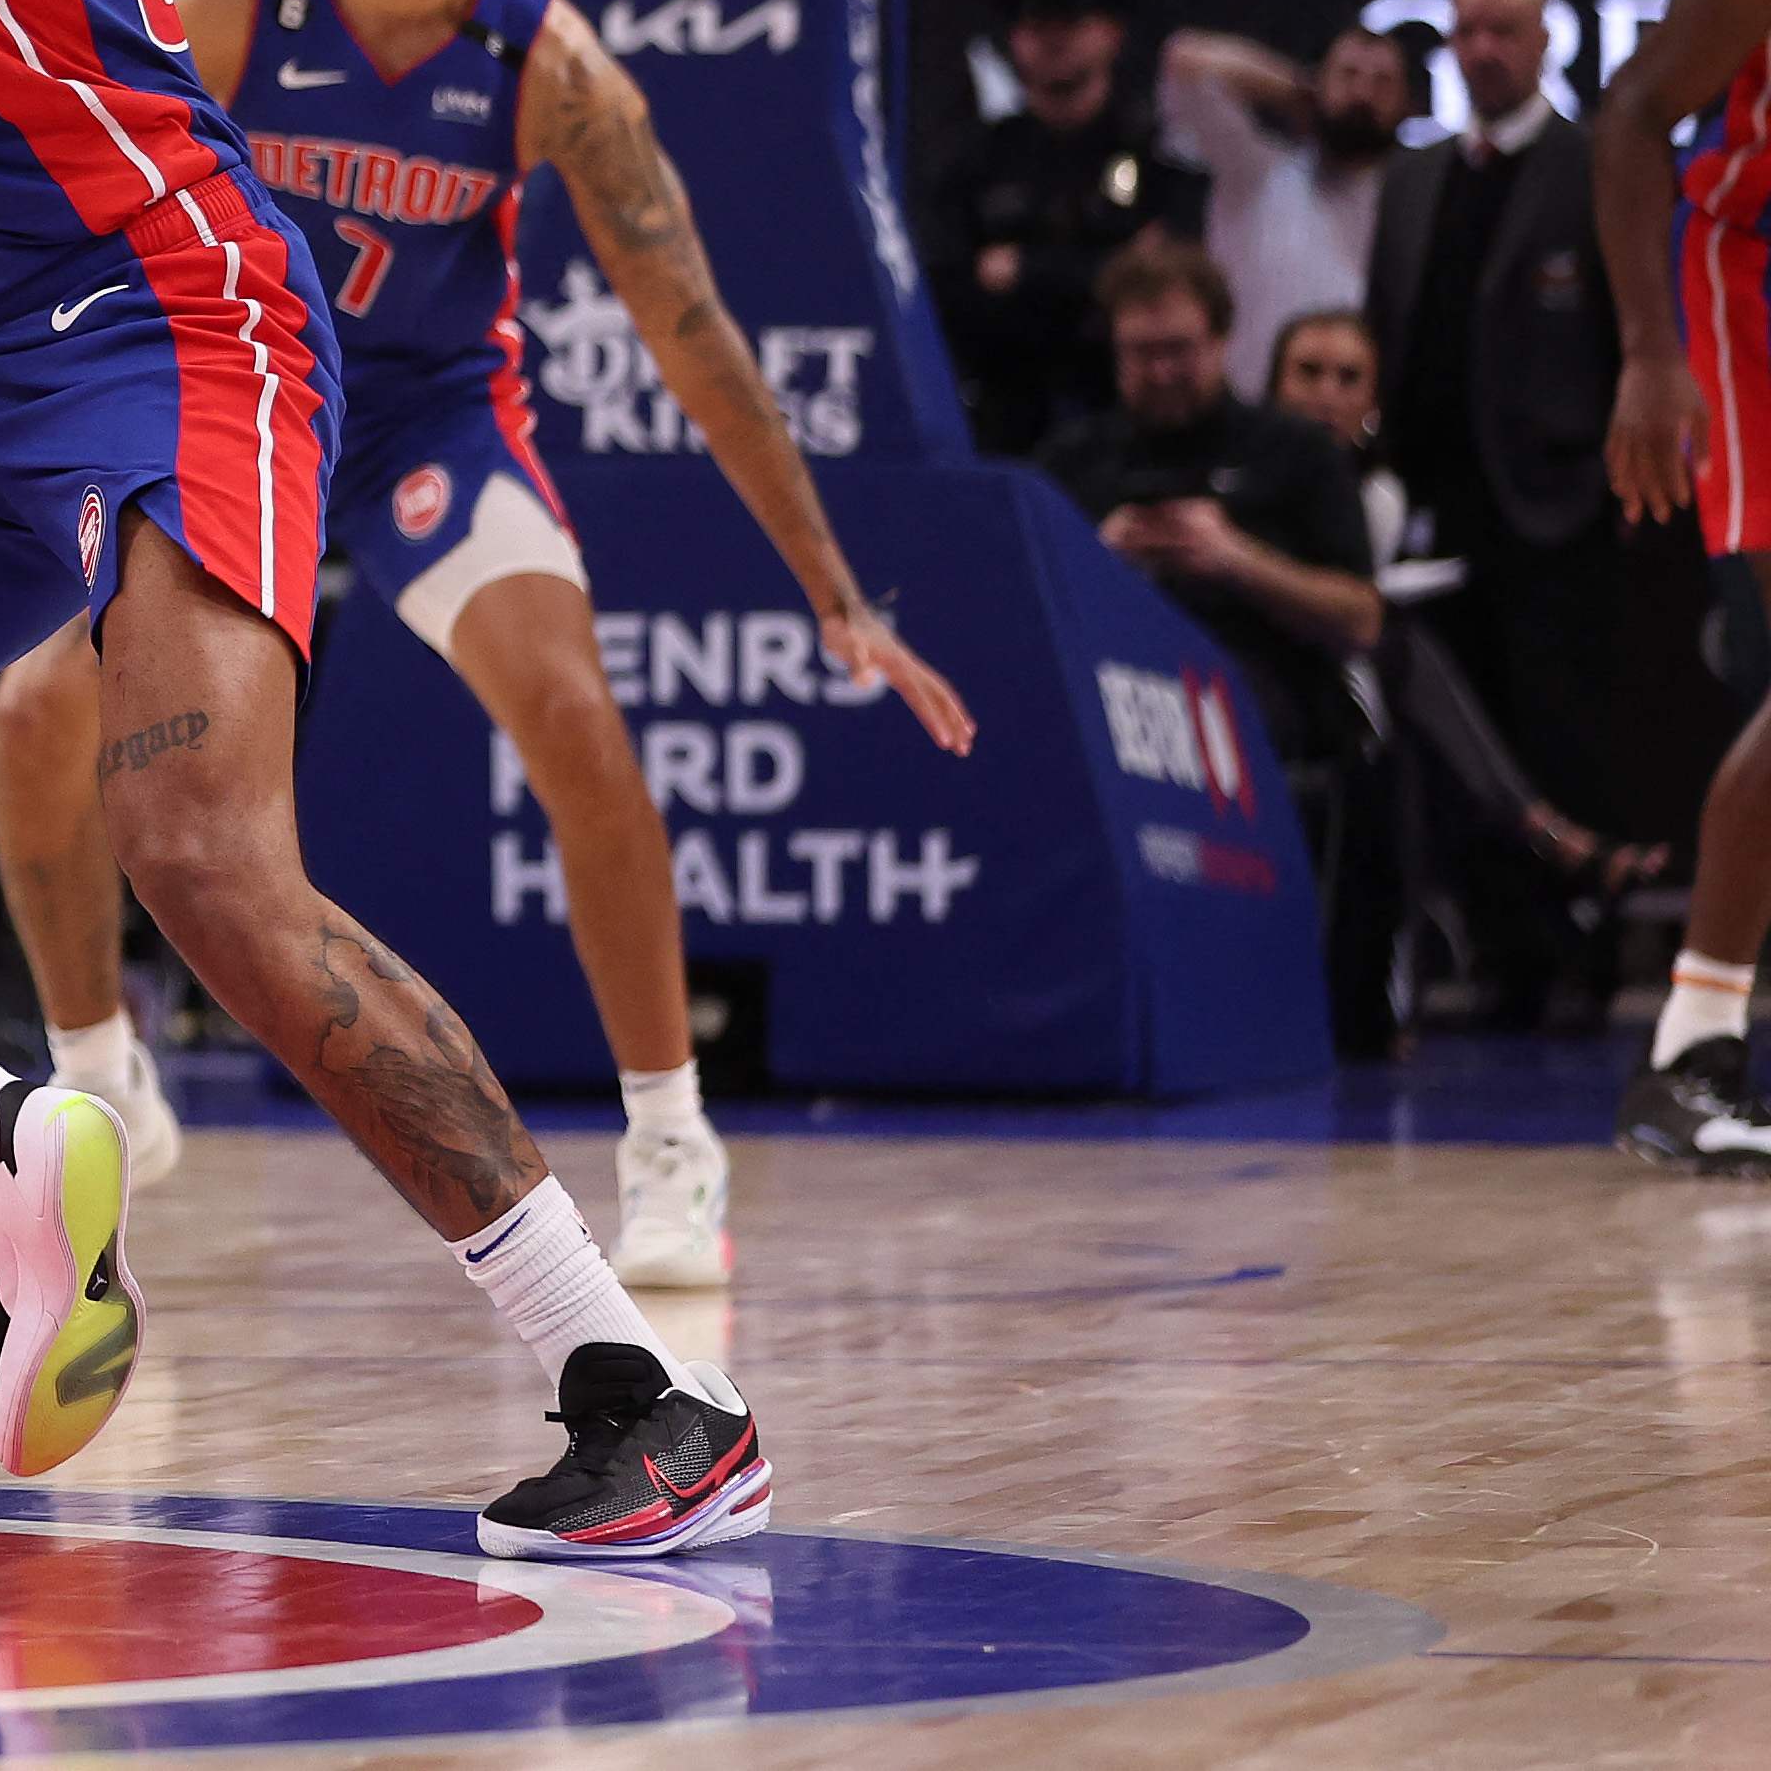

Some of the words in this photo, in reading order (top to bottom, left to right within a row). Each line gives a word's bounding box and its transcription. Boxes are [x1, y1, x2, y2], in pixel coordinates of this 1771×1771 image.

[249, 132, 499, 225] DETROIT
[333, 217, 395, 318] 7
[489, 719, 804, 817] FRD
[489, 829, 981, 925] HALTH
